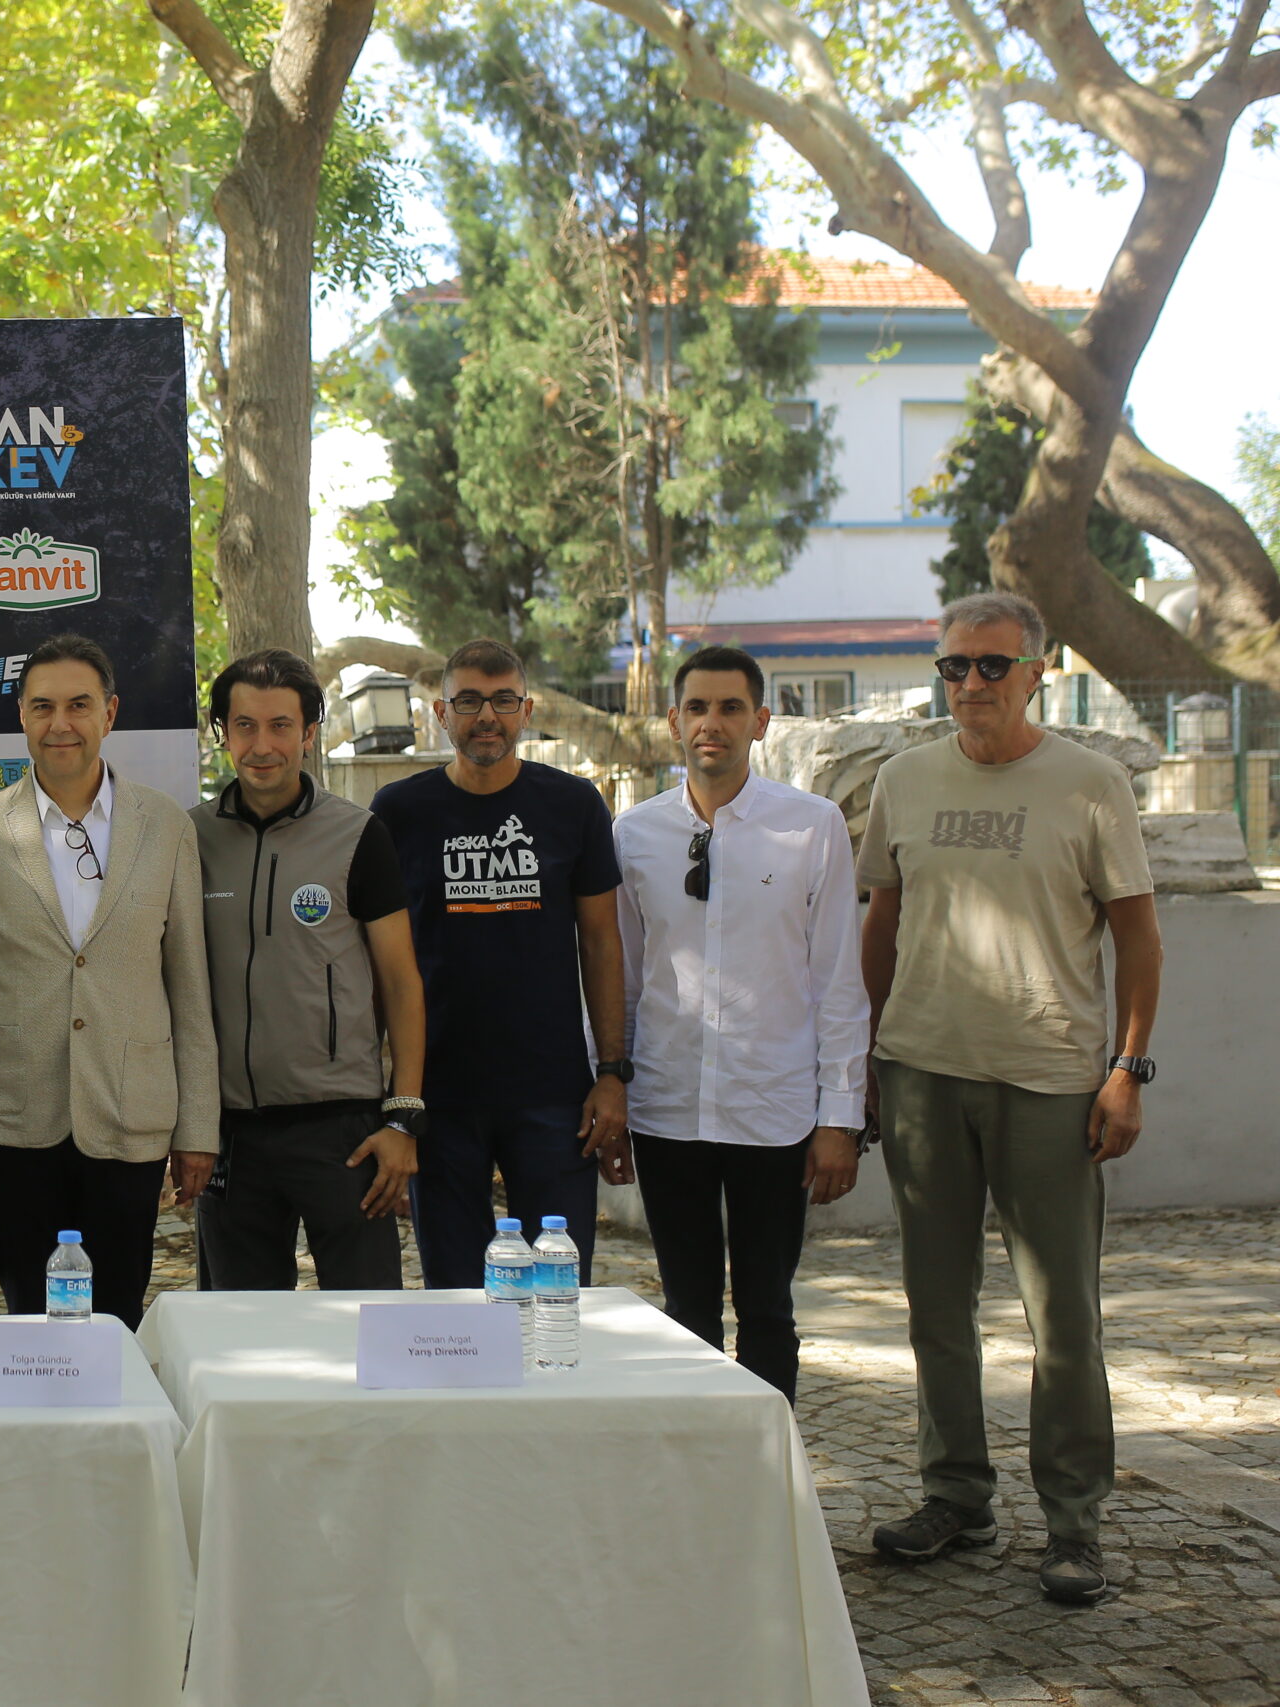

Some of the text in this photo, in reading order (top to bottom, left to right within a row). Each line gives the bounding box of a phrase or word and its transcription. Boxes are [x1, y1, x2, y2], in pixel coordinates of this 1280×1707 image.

[0, 491, 24, 500] KÜLTÜR
[928, 806, 1028, 859] mavi
[443, 835, 491, 853] HOKA
[443, 847, 539, 880] UTMB
[494, 1267, 521, 1280] Erikli
[414, 1335, 445, 1344] Osman
[408, 1347, 478, 1358] Yarış Direktörü
[11, 1355, 35, 1365] Tolga
[2, 1367, 80, 1377] Banvit BRF CEO
